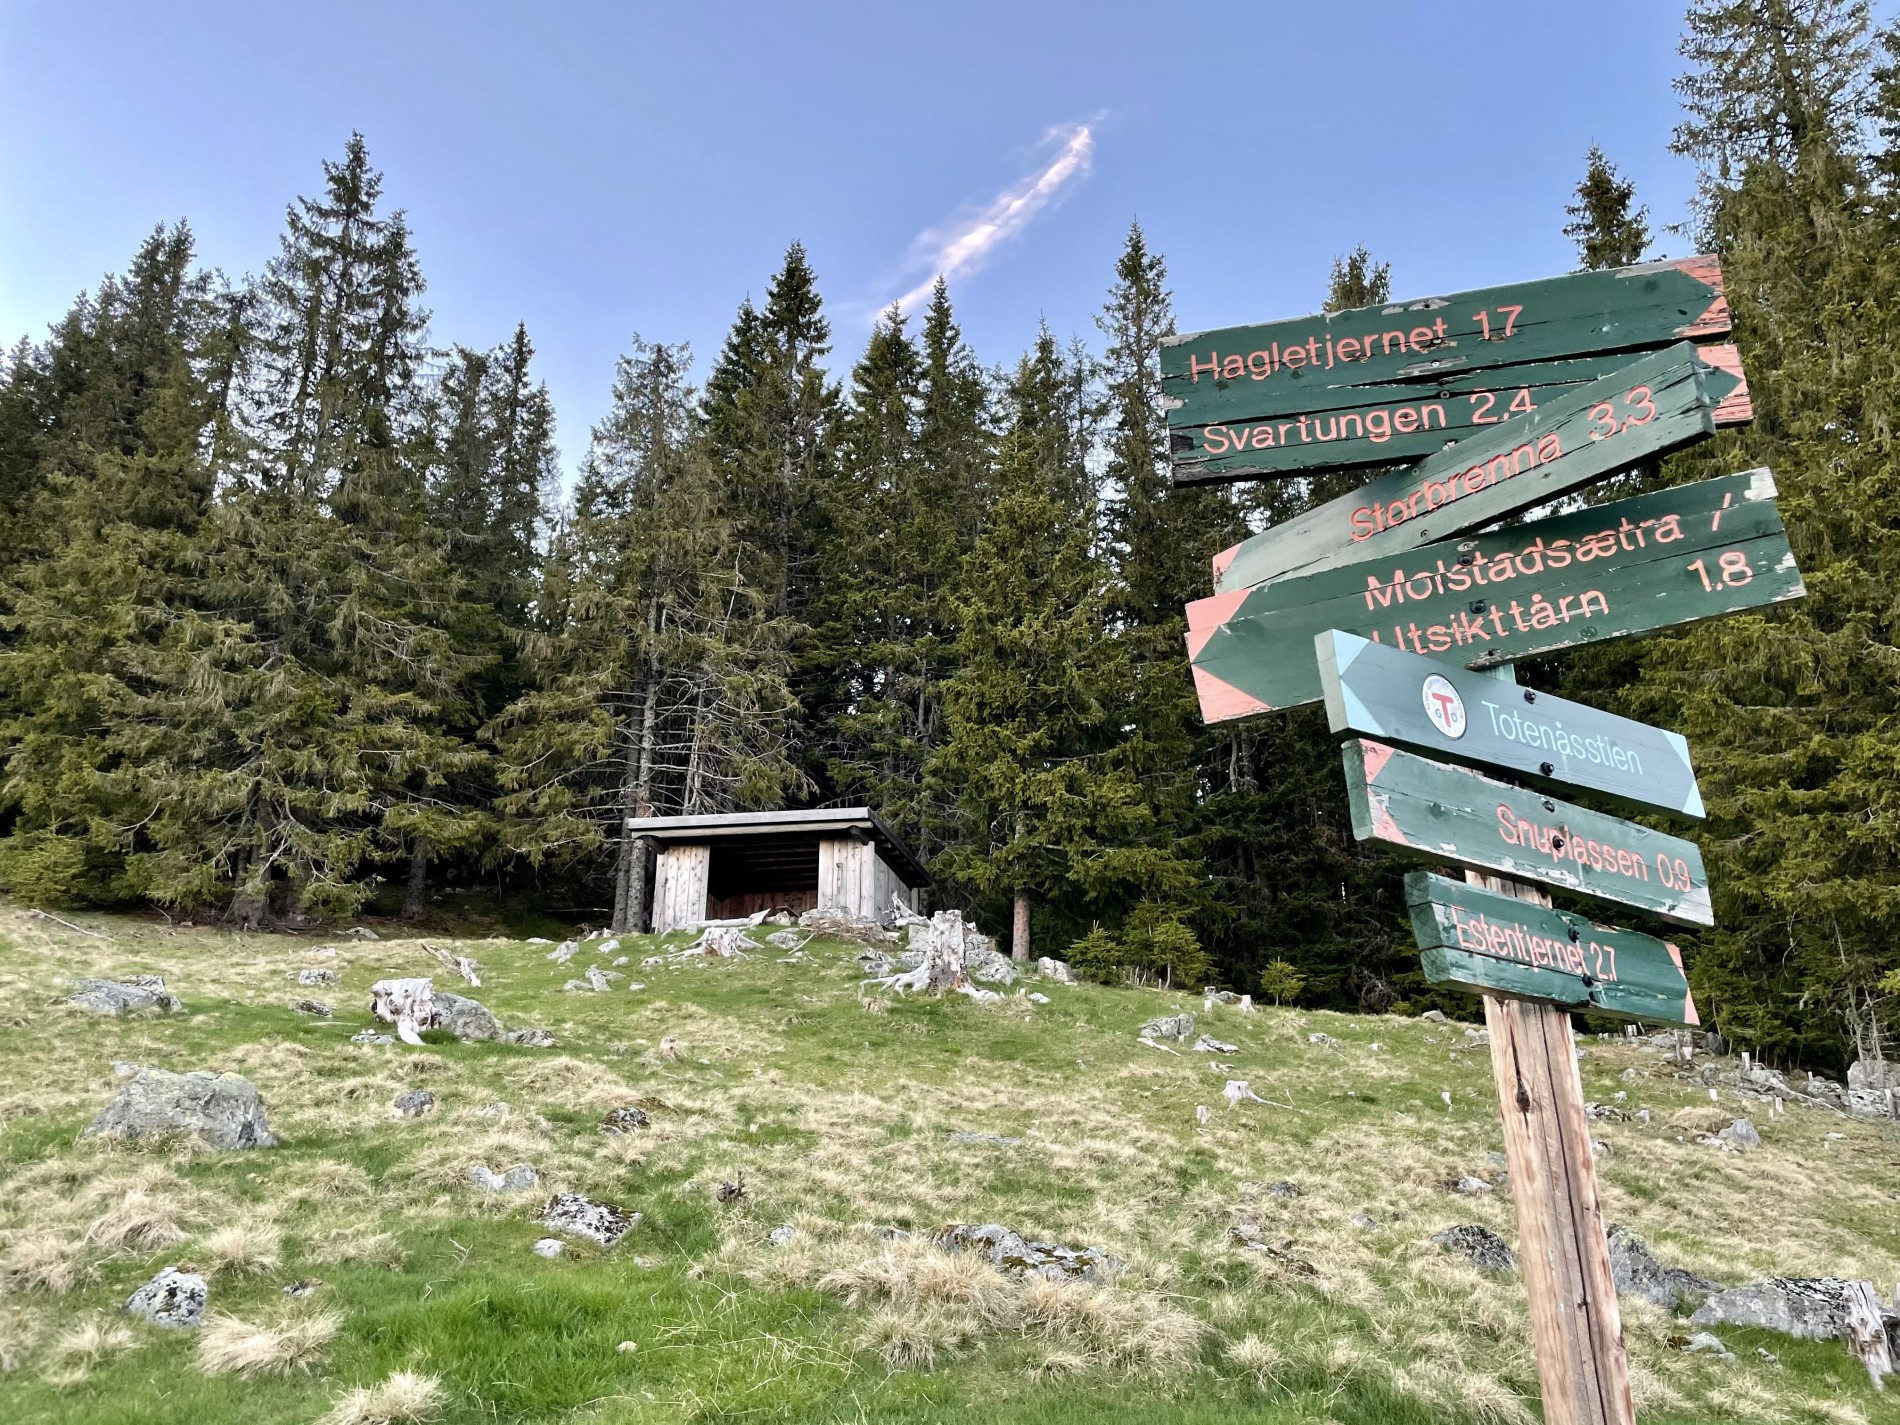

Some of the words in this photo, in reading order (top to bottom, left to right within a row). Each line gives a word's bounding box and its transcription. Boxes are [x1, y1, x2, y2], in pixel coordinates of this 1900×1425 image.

[1190, 316, 1448, 384] Hagletjernet
[1472, 305, 1524, 340] 17
[1203, 400, 1446, 455] Svartungen
[1350, 432, 1563, 542] Storbrenna
[1364, 513, 1684, 611] Molstadsætra
[1481, 700, 1644, 775] Totenåsstien
[1496, 803, 1648, 882] Snuplassen
[1451, 905, 1591, 976] Estentjernet
